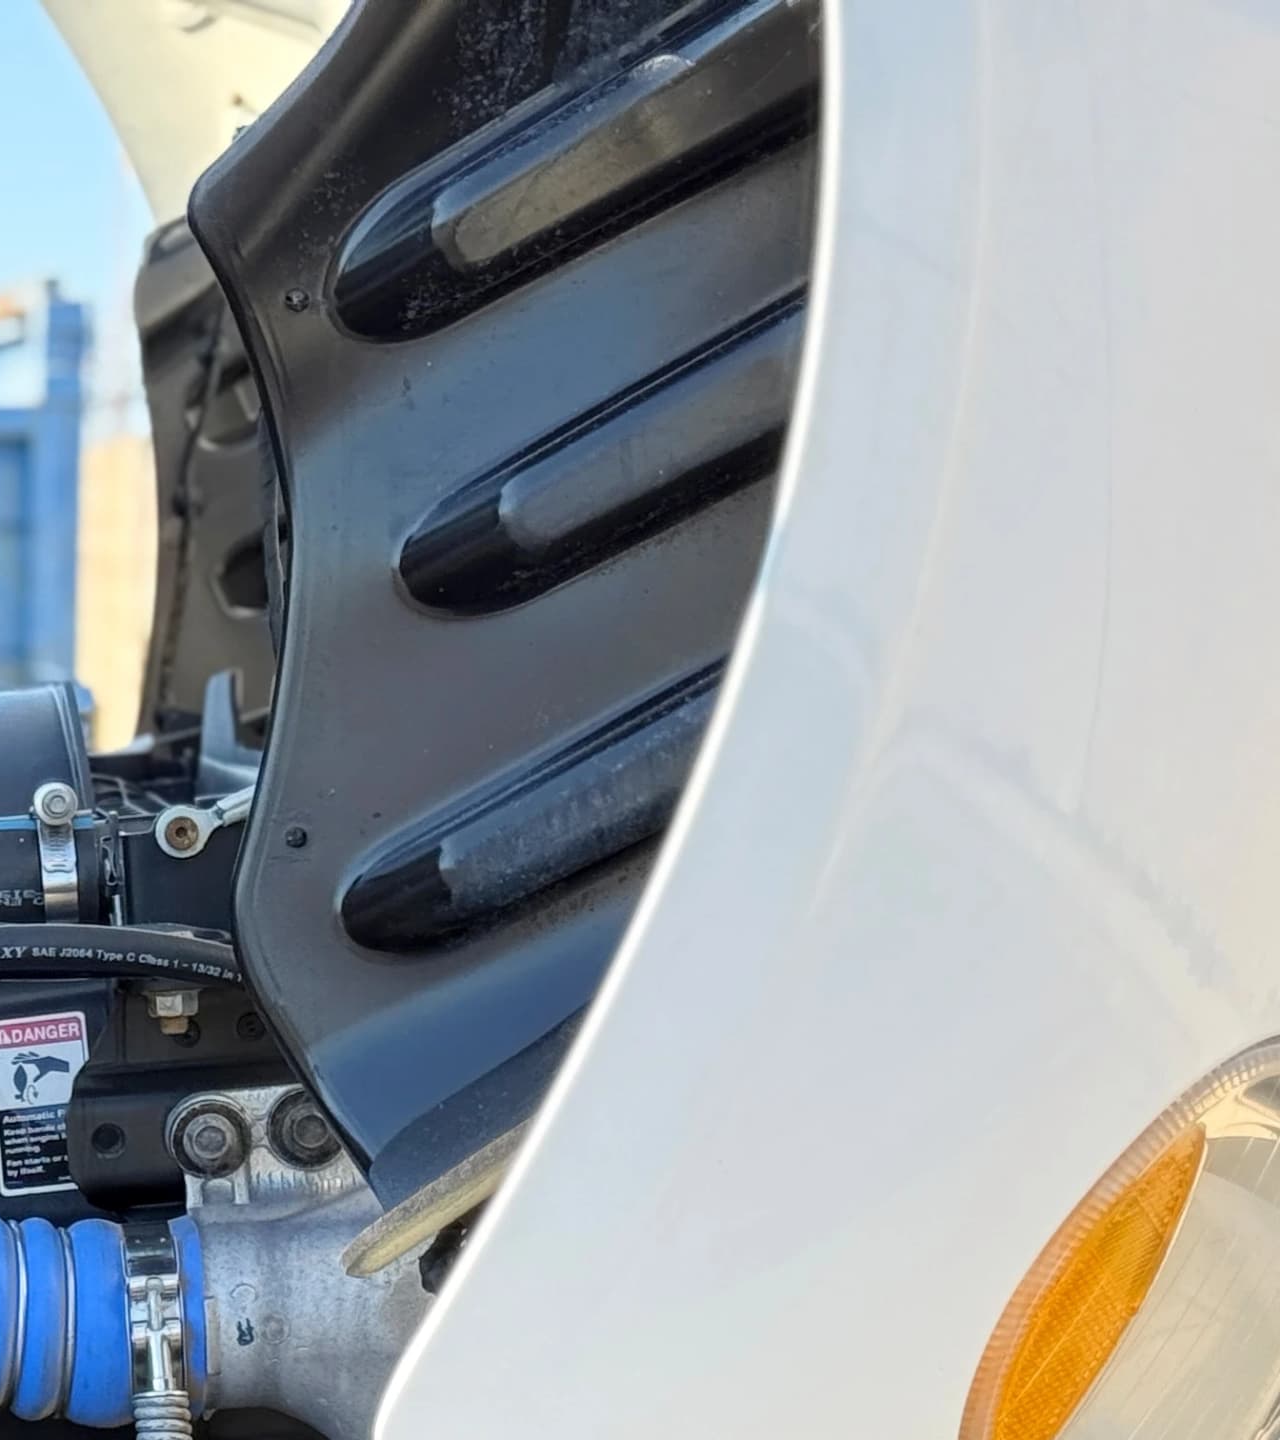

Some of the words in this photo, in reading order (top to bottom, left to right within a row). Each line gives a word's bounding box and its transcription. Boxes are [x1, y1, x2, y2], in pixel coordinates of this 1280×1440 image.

[31, 948, 56, 958] SAE
[95, 949, 123, 962] Type
[126, 952, 136, 963] C
[137, 953, 169, 968] Class
[11, 1023, 80, 1043] DANGER
[3, 1111, 56, 1124] Automatic
[3, 1128, 26, 1136] Keep
[28, 1125, 55, 1134] hands
[4, 1137, 28, 1145] when
[30, 1134, 60, 1143] engine
[24, 1157, 50, 1165] starts
